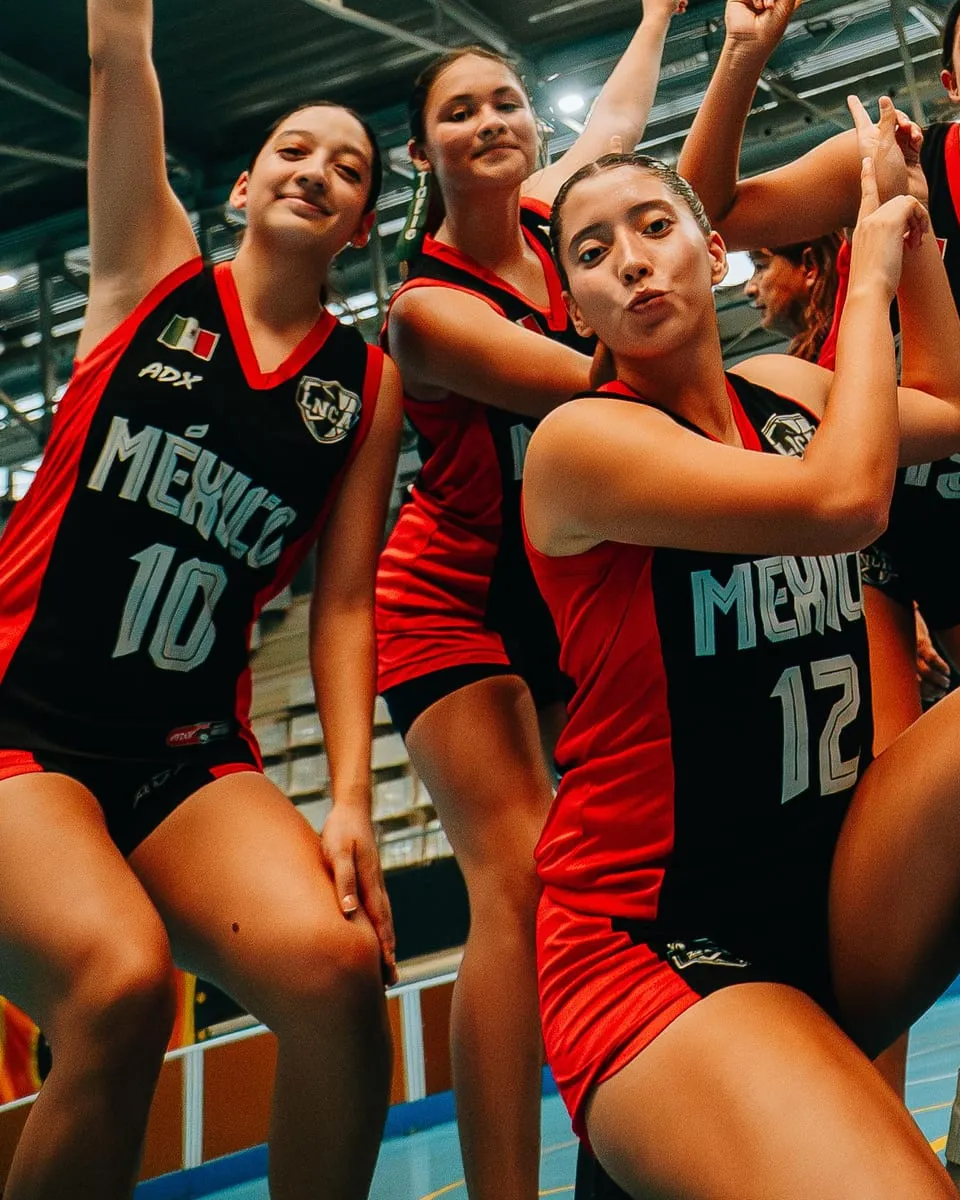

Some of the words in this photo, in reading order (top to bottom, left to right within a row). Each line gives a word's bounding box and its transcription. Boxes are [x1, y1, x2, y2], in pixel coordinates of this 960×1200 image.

[138, 362, 203, 390] ADX
[301, 392, 353, 432] LNCA
[112, 543, 228, 673] 10
[769, 654, 862, 805] 12
